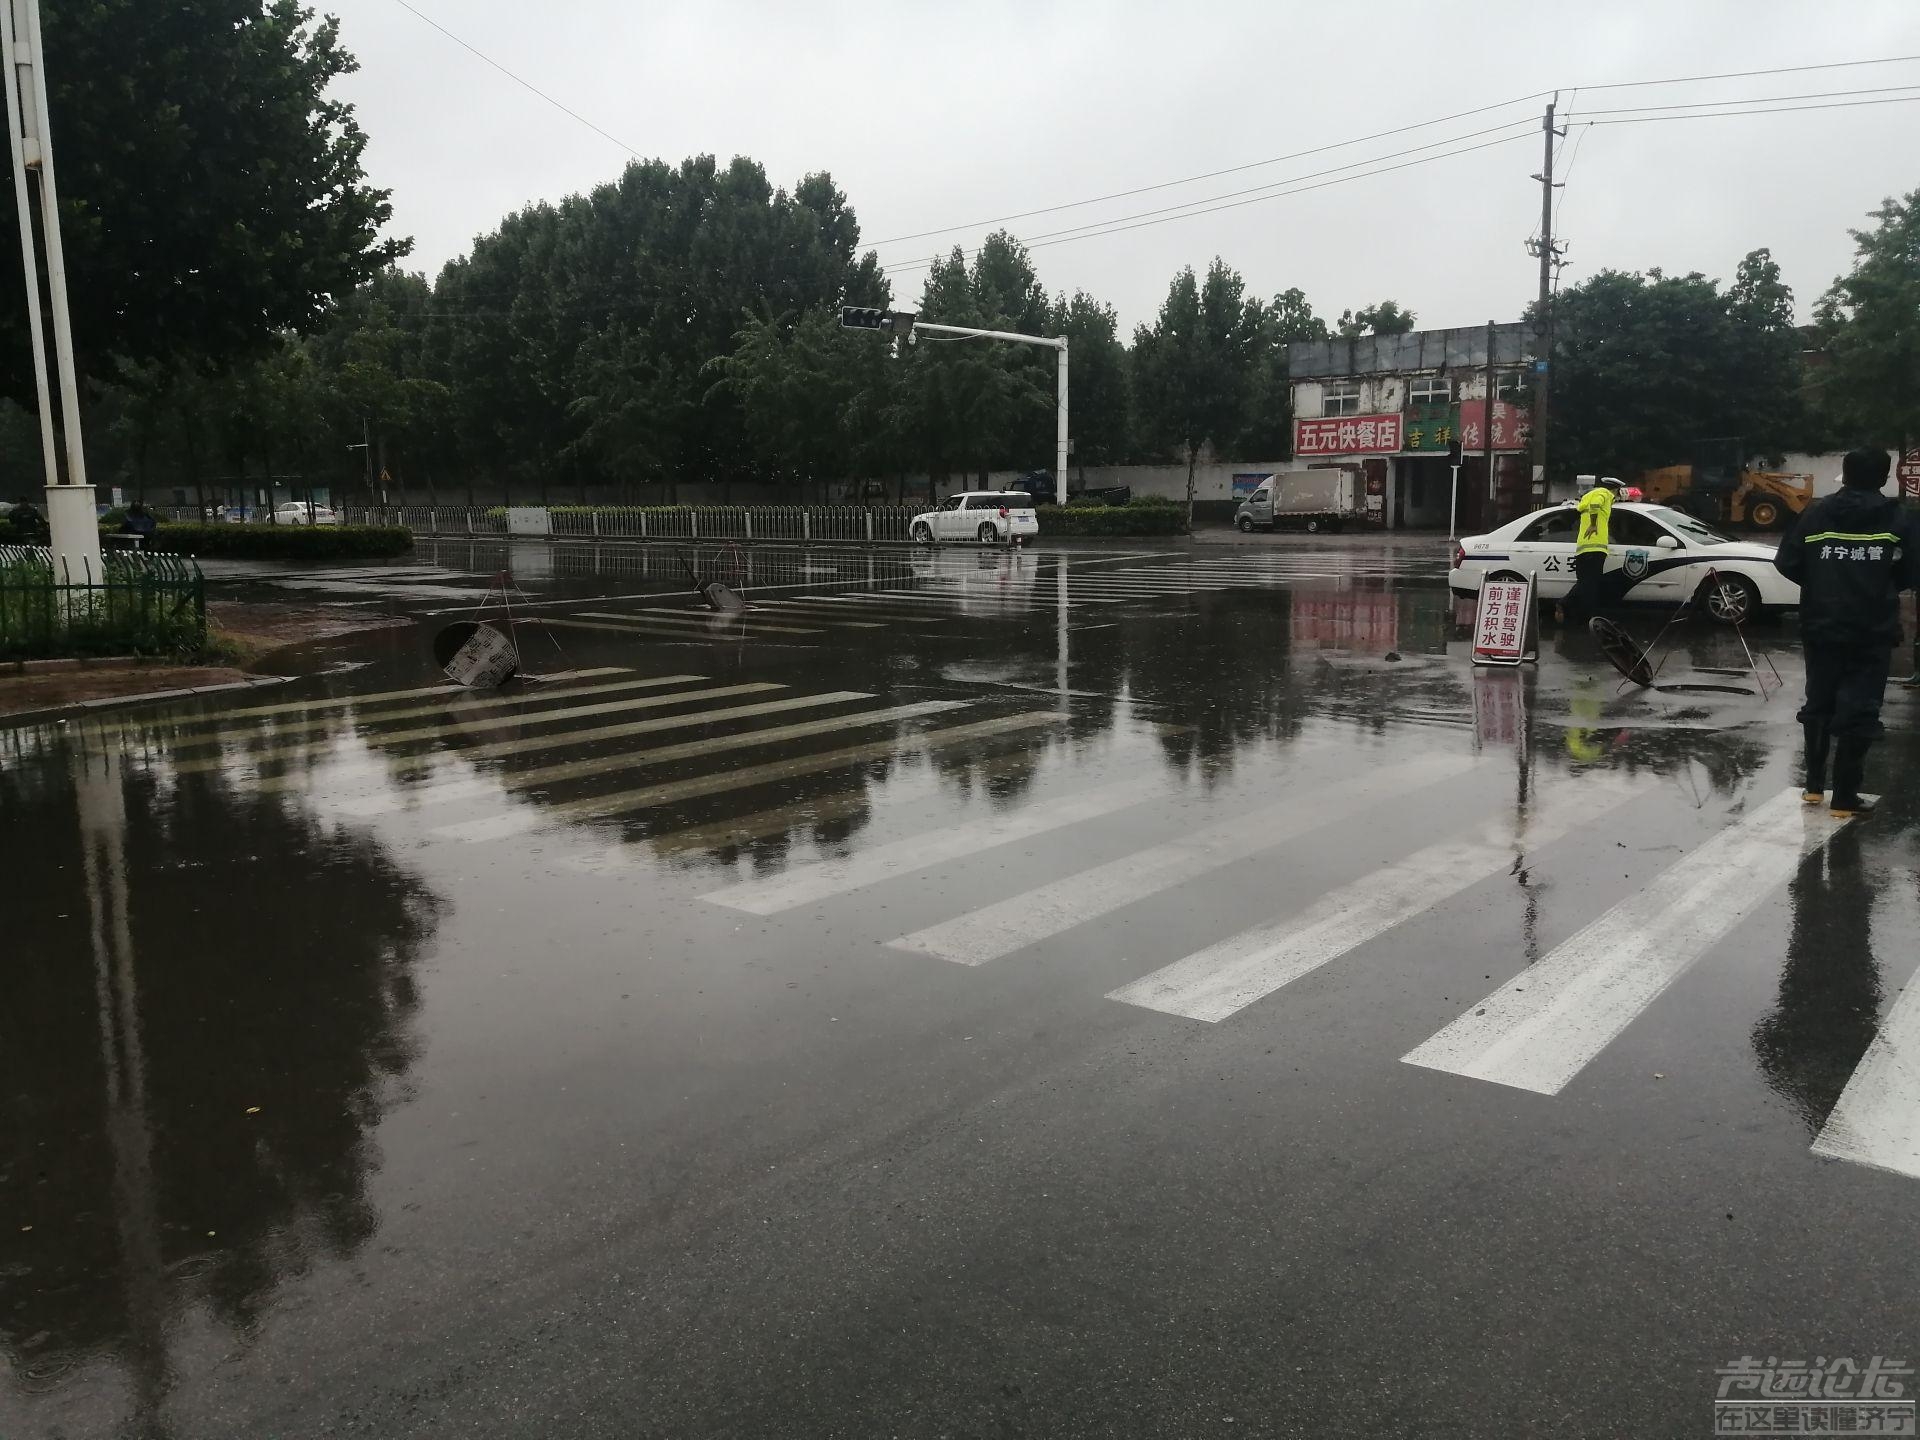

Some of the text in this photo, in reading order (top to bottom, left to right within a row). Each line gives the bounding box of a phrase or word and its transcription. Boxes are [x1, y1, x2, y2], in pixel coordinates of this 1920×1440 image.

[1299, 420, 1397, 450] 五元快餐店
[1408, 426, 1452, 448] 吉祥
[1481, 586, 1504, 646] 前方积水
[1499, 586, 1522, 647] 谨慎驾驶
